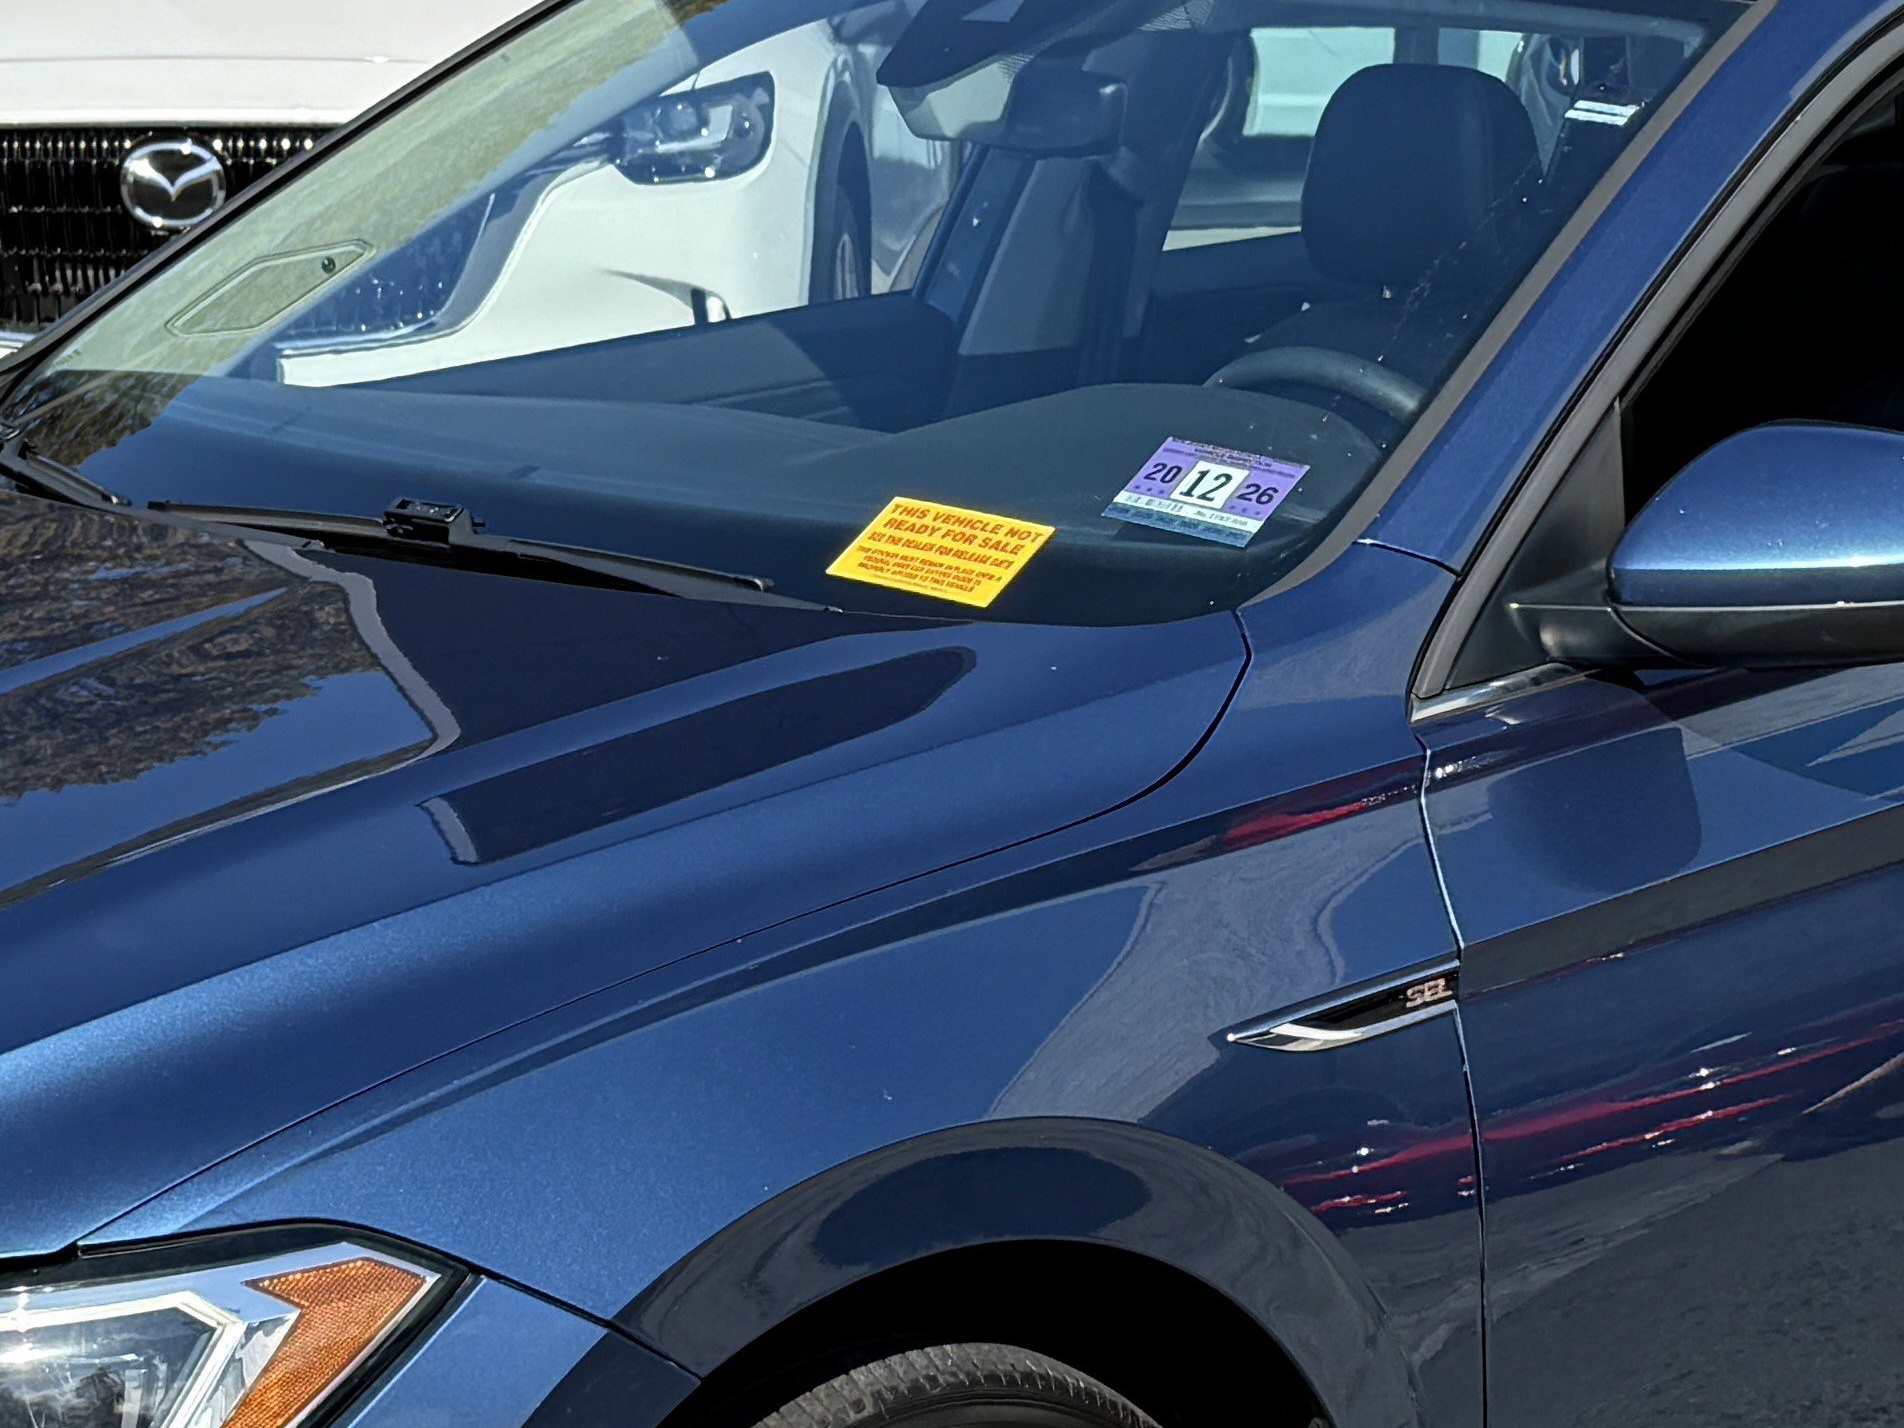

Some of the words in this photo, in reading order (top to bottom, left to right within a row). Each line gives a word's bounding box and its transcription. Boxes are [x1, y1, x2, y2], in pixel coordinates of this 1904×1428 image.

[1143, 462, 1183, 484] 20
[1179, 469, 1233, 502] 12
[1236, 483, 1279, 505] 26
[883, 517, 942, 538] READY
[941, 529, 978, 546] FOR
[978, 536, 1026, 556] SALE
[891, 504, 930, 520] THIS
[932, 511, 1004, 535] VEHICLE
[1004, 526, 1044, 543] NOT
[1406, 977, 1453, 1008] SEL
